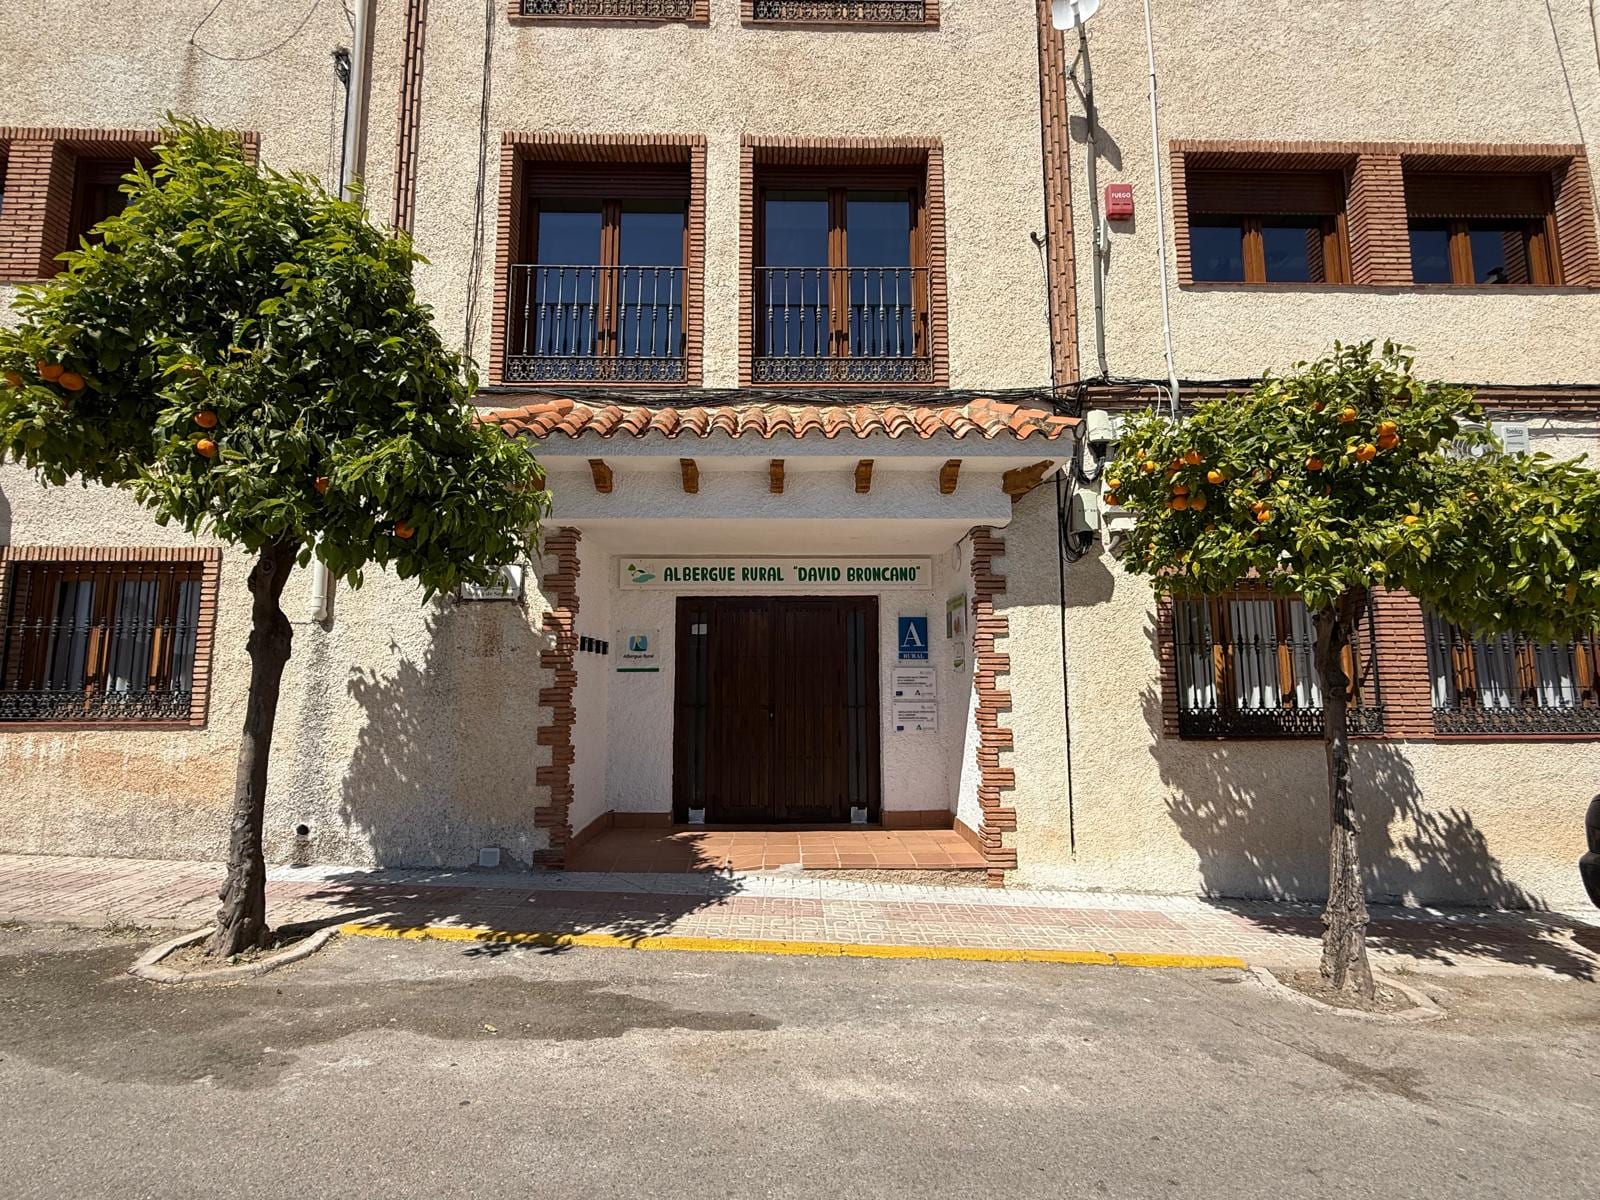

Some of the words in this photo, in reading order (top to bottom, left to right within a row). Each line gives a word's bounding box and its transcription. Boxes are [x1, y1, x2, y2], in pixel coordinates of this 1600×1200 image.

[663, 567, 736, 582] ALBERGUE
[741, 567, 785, 582] RURAL
[900, 621, 926, 647] A
